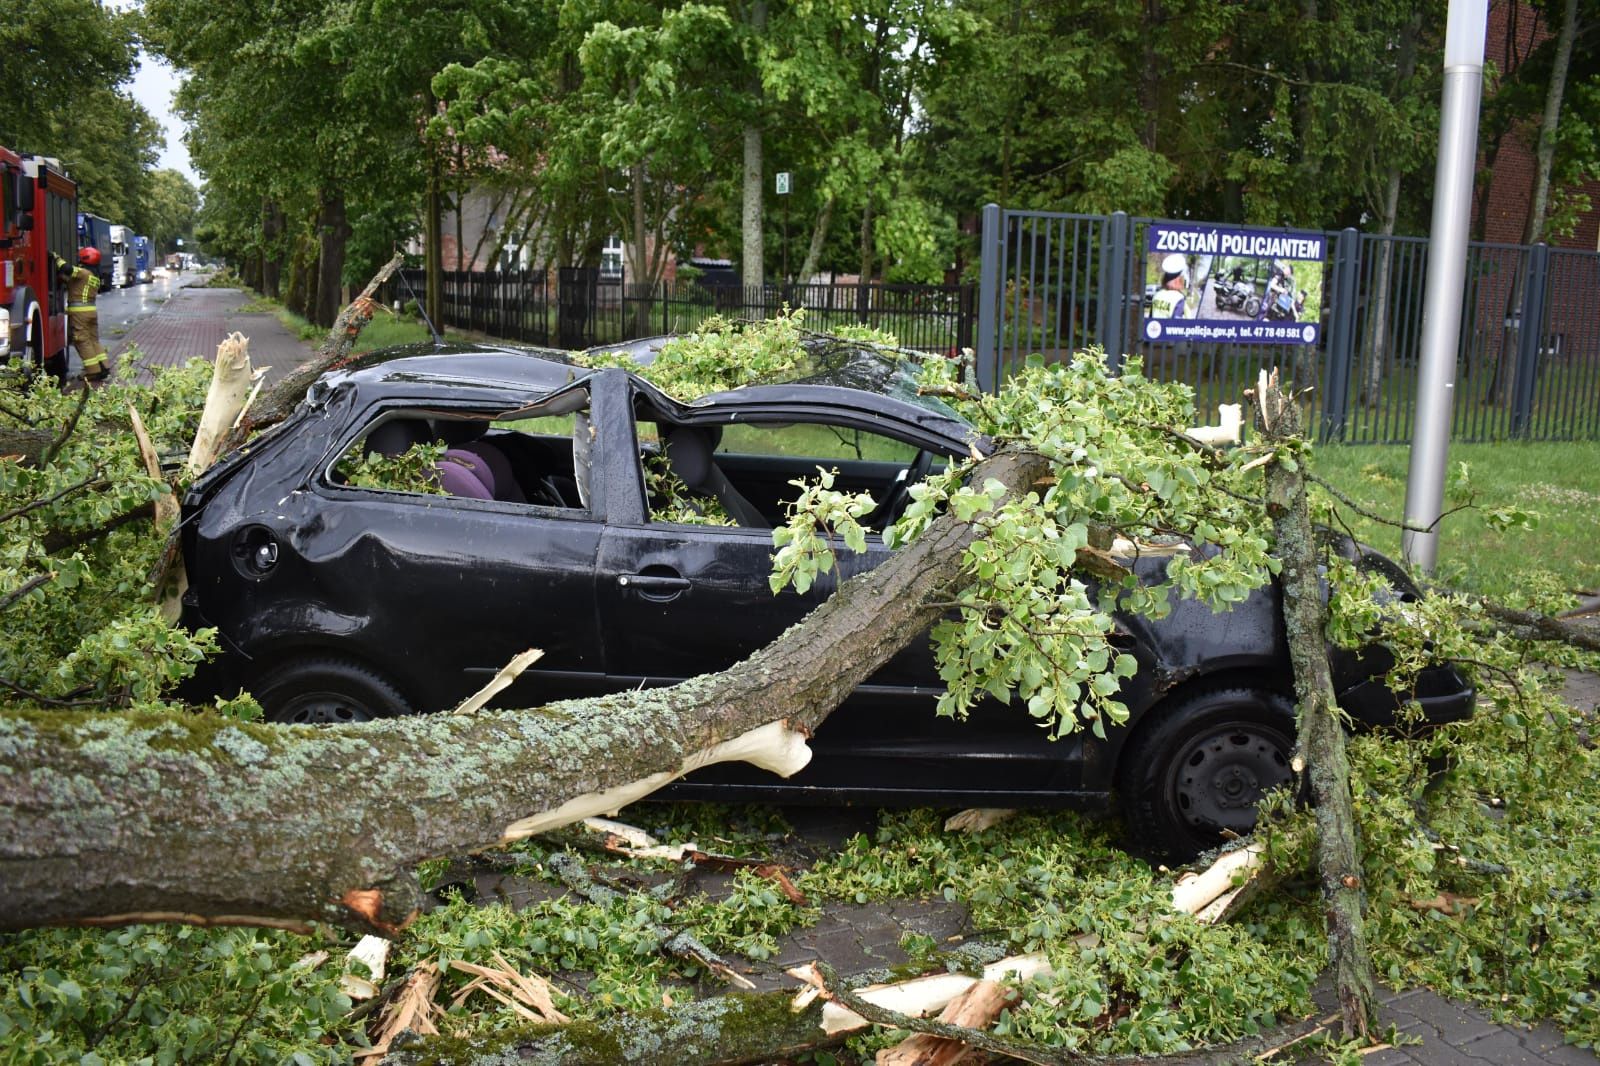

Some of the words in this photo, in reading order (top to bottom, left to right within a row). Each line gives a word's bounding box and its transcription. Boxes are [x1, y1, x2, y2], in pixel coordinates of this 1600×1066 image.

[1157, 229, 1218, 253] ZOSTAŃ
[1221, 234, 1320, 259] POLICJANTEM
[1240, 327, 1252, 337] tel.
[1253, 327, 1263, 337] 47
[1265, 327, 1275, 337] 78
[1275, 327, 1285, 338] 49
